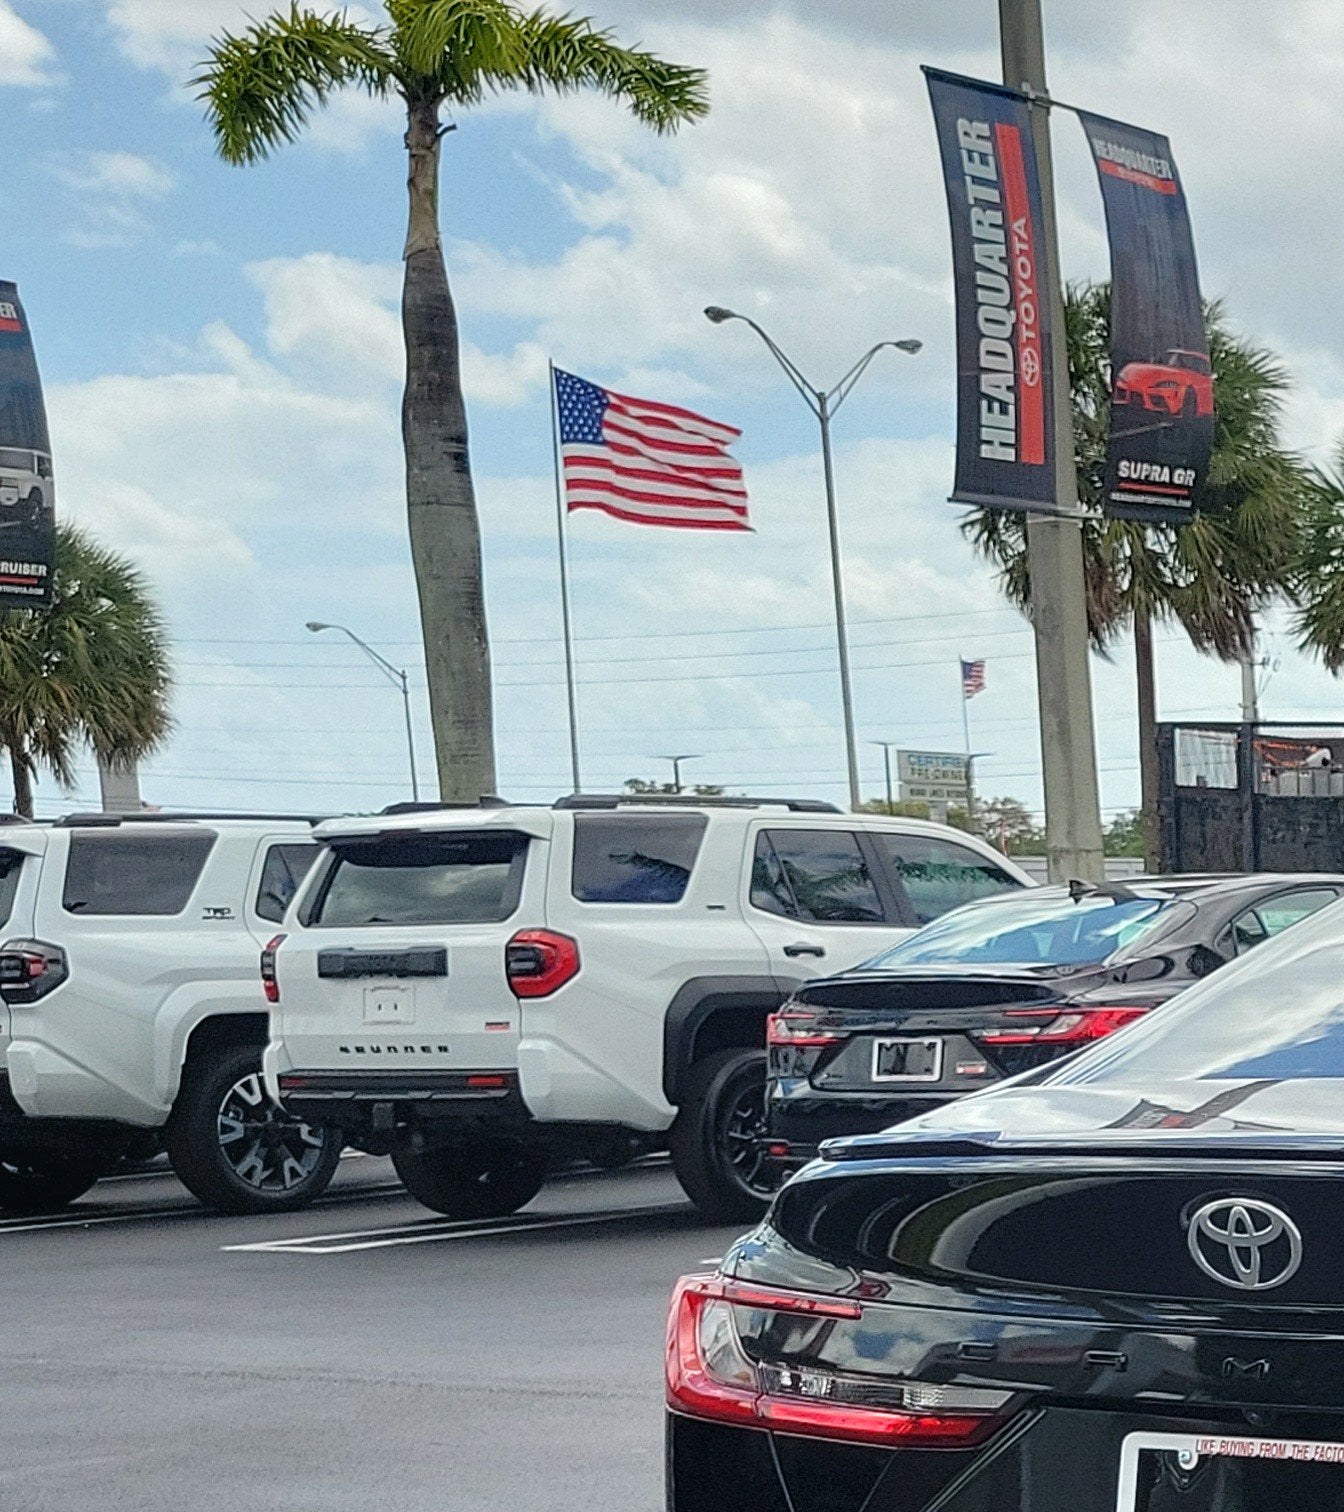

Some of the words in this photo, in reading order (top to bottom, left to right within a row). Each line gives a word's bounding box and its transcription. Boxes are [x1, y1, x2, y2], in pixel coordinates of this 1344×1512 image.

[957, 118, 1016, 463] HEADQUARTER
[1012, 217, 1036, 341] TOYOTA
[1118, 460, 1170, 483] SUPRA
[1172, 468, 1196, 487] GR
[1196, 1438, 1215, 1454] LIKE
[1219, 1440, 1255, 1456] BUYING
[1259, 1442, 1287, 1459] FROM
[1292, 1444, 1311, 1461] THE
